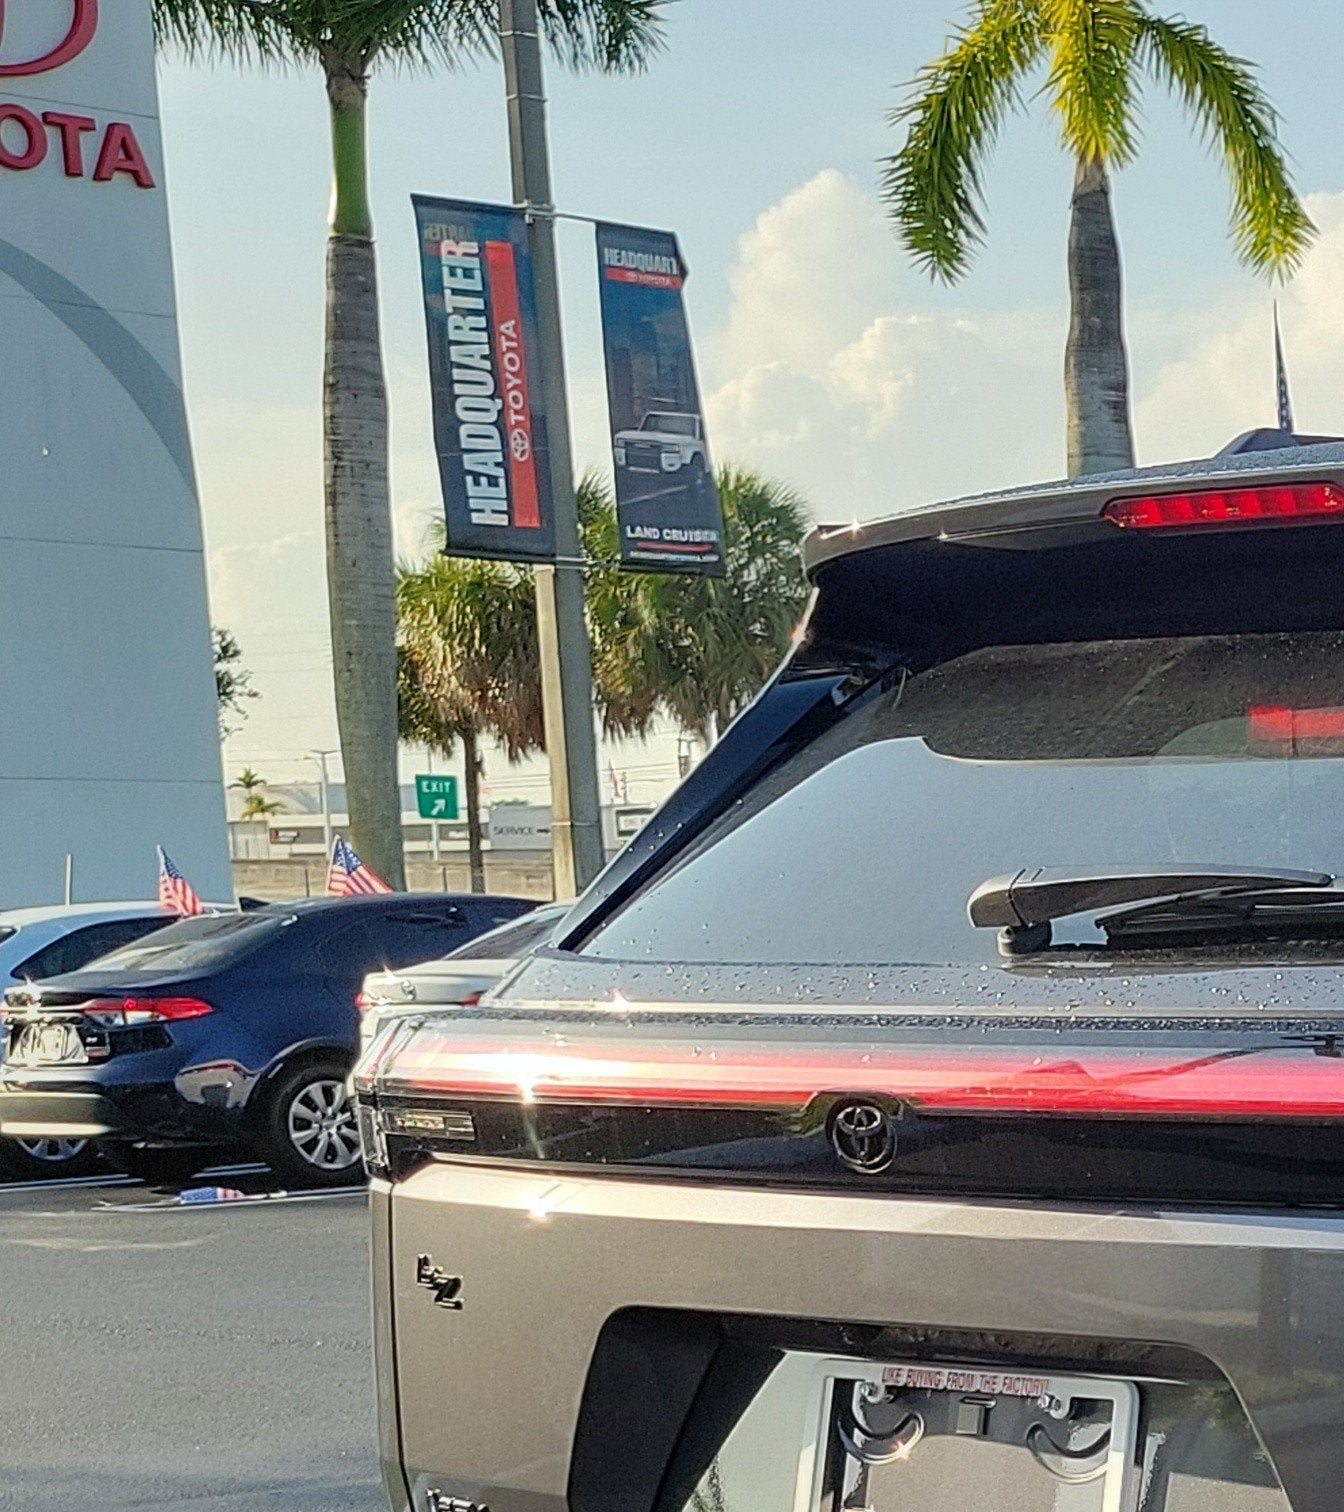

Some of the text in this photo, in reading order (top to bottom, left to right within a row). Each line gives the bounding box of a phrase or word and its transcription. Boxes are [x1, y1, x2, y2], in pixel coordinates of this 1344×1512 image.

[0, 103, 156, 188] OTA
[440, 239, 509, 527] HEADQUARTER
[500, 319, 526, 426] TOYOTA
[626, 525, 660, 539] LAND
[421, 780, 451, 793] EXIT
[493, 825, 534, 836] SERVICE
[947, 1372, 974, 1391] FROM
[980, 1374, 998, 1393] THE
